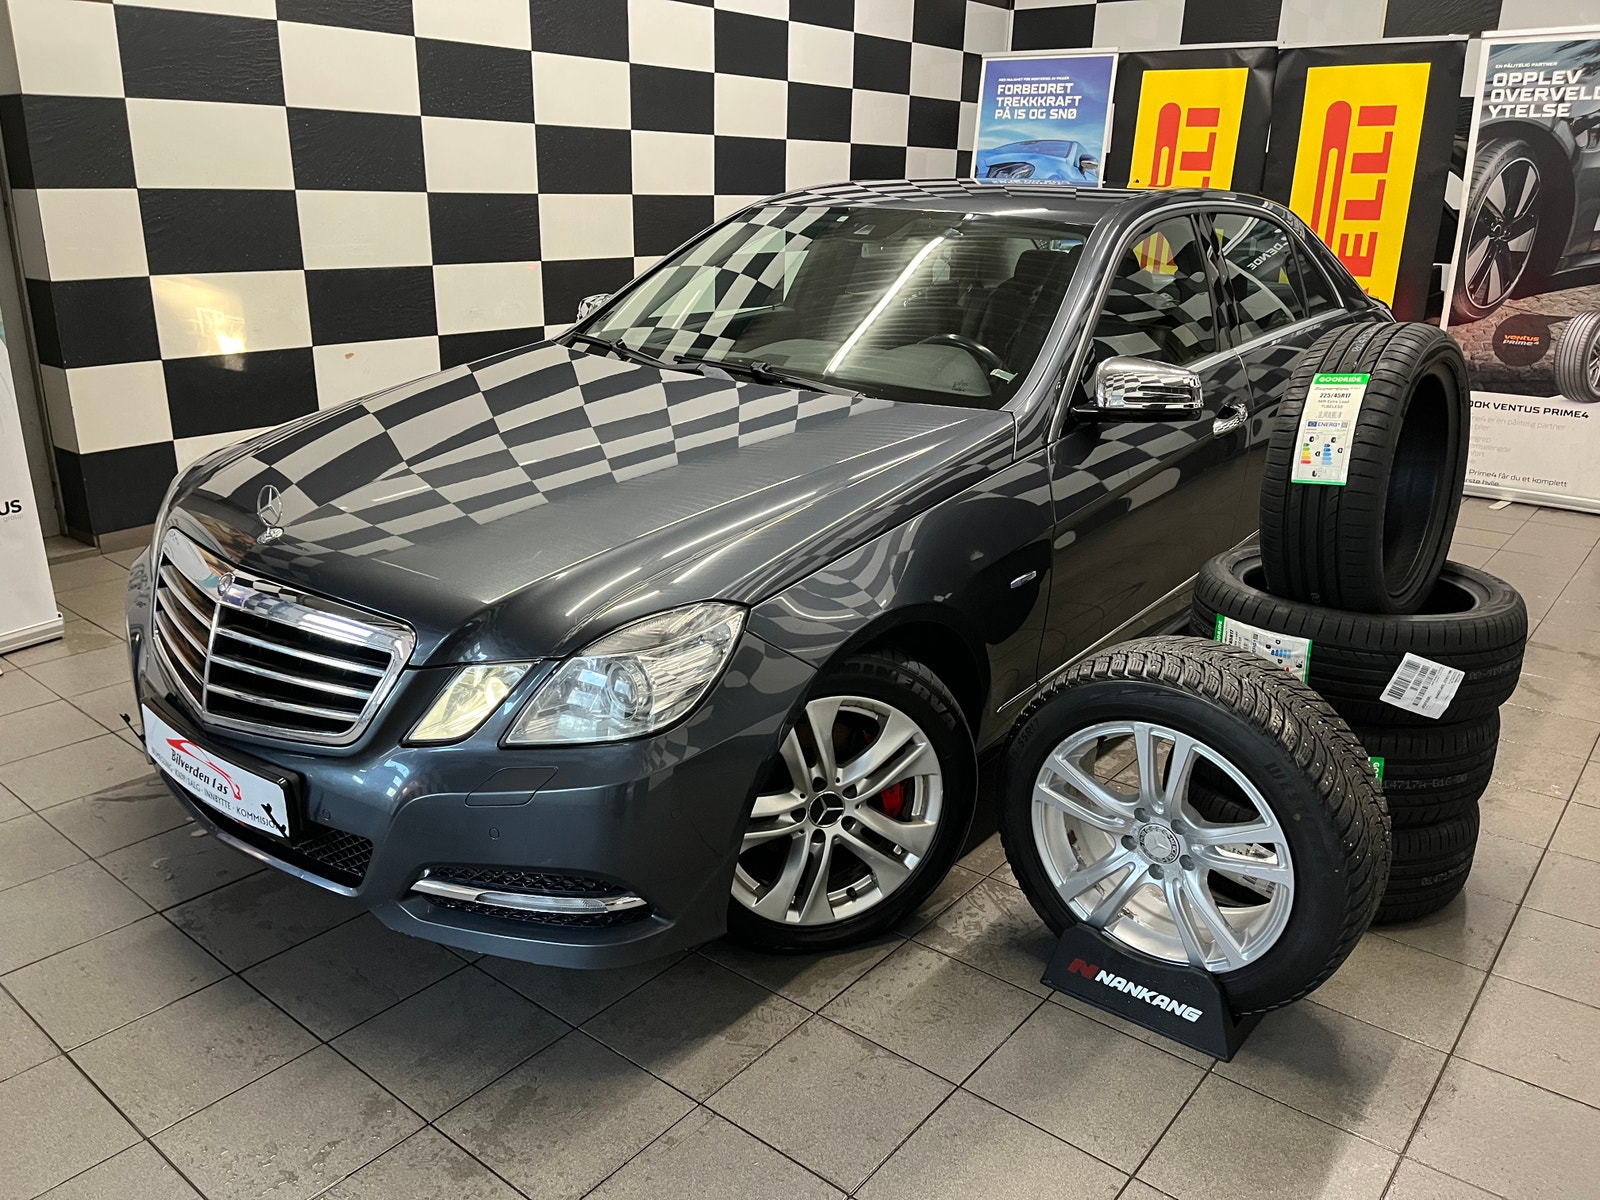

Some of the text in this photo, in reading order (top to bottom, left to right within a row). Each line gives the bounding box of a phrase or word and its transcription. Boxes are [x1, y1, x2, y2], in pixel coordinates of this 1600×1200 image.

[1492, 70, 1583, 87] OPPLEV
[997, 82, 1074, 95] FORBEDRET
[996, 95, 1082, 107] TREKKKRAFT
[995, 107, 1078, 120] PÅ IS OG SNØ
[1488, 103, 1572, 118] YTELSE
[1493, 402, 1541, 414] VENTUS
[1543, 407, 1589, 419] PRIME4
[1469, 468, 1497, 478] Prime4
[1498, 472, 1509, 480] får
[1532, 477, 1568, 488] komplett
[170, 747, 211, 785] Bilverden
[217, 783, 229, 795] as
[236, 807, 278, 829] KOMMISJO
[1094, 969, 1203, 1024] NANKANG
